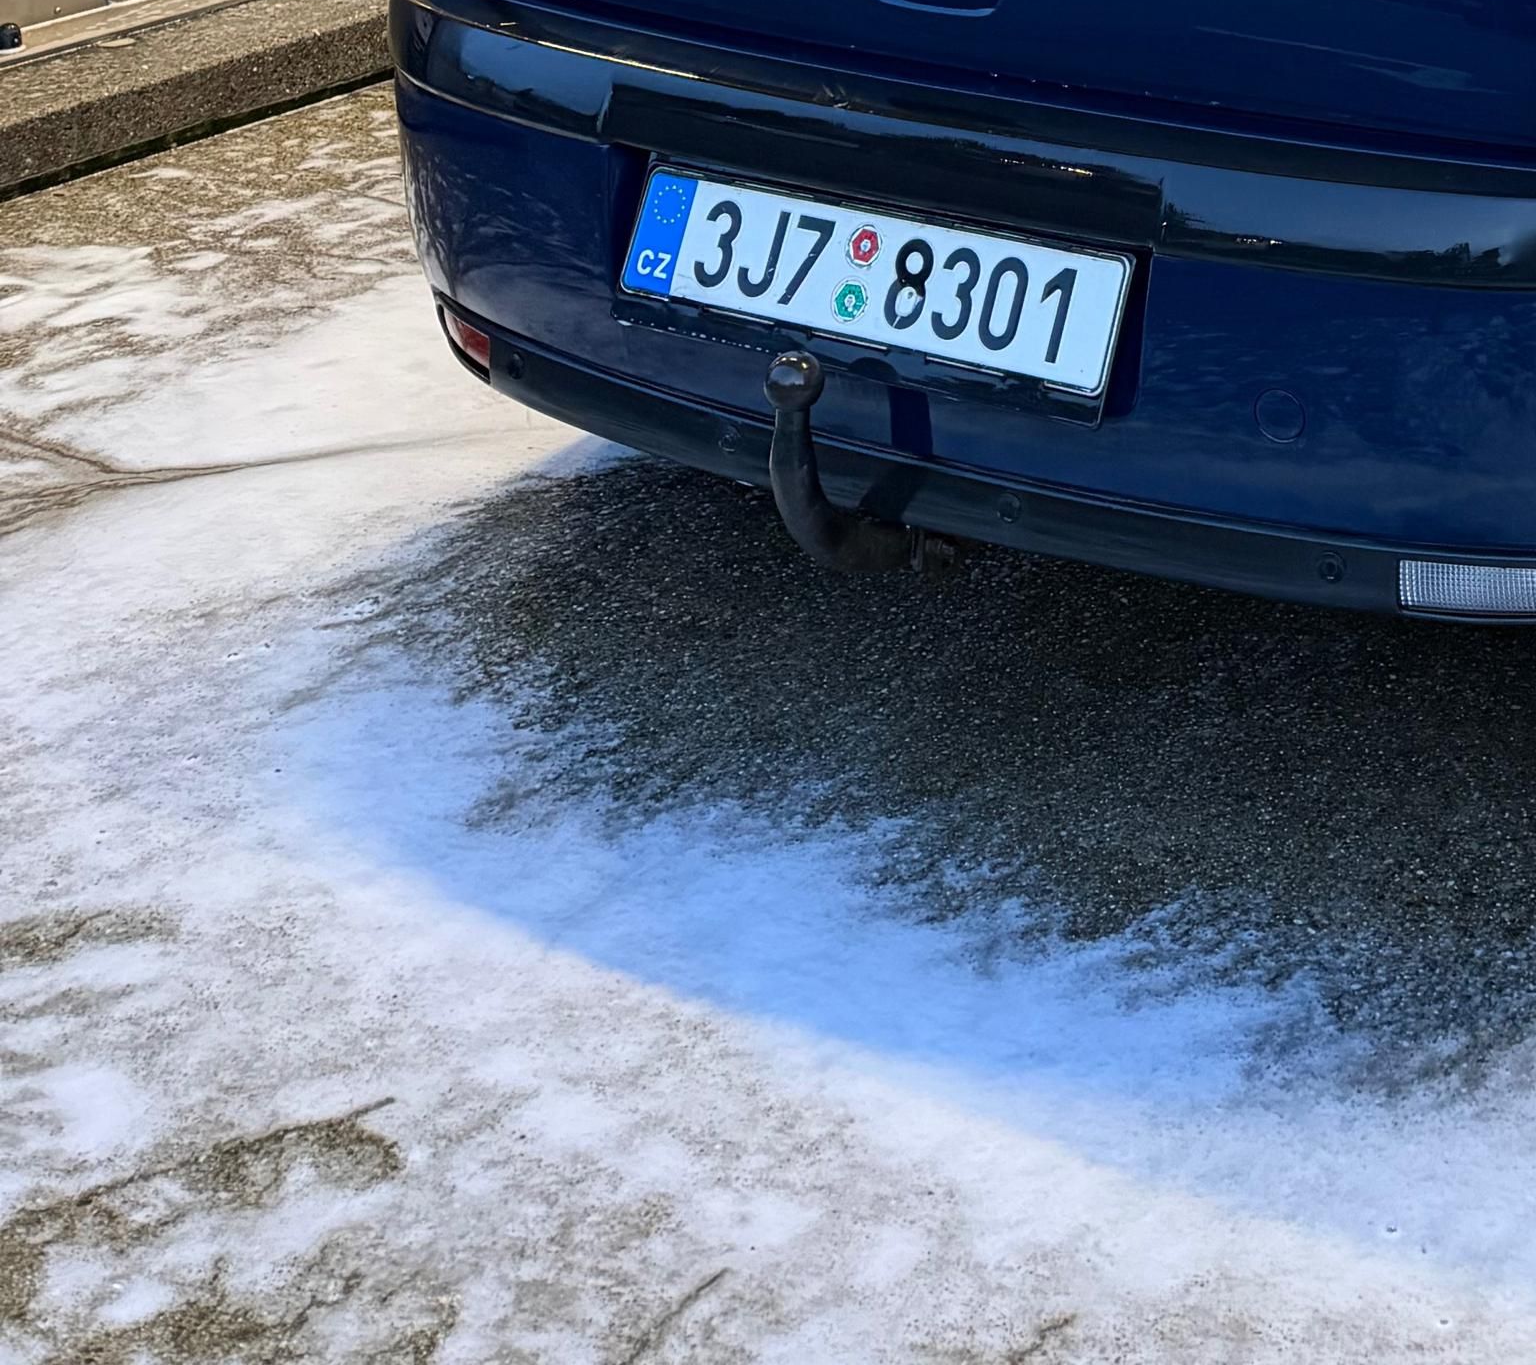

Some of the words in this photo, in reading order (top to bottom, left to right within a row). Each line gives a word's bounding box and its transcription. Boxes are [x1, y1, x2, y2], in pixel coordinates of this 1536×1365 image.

[637, 248, 671, 280] CZ
[693, 200, 836, 305] 3J7
[883, 239, 1078, 363] 8301
